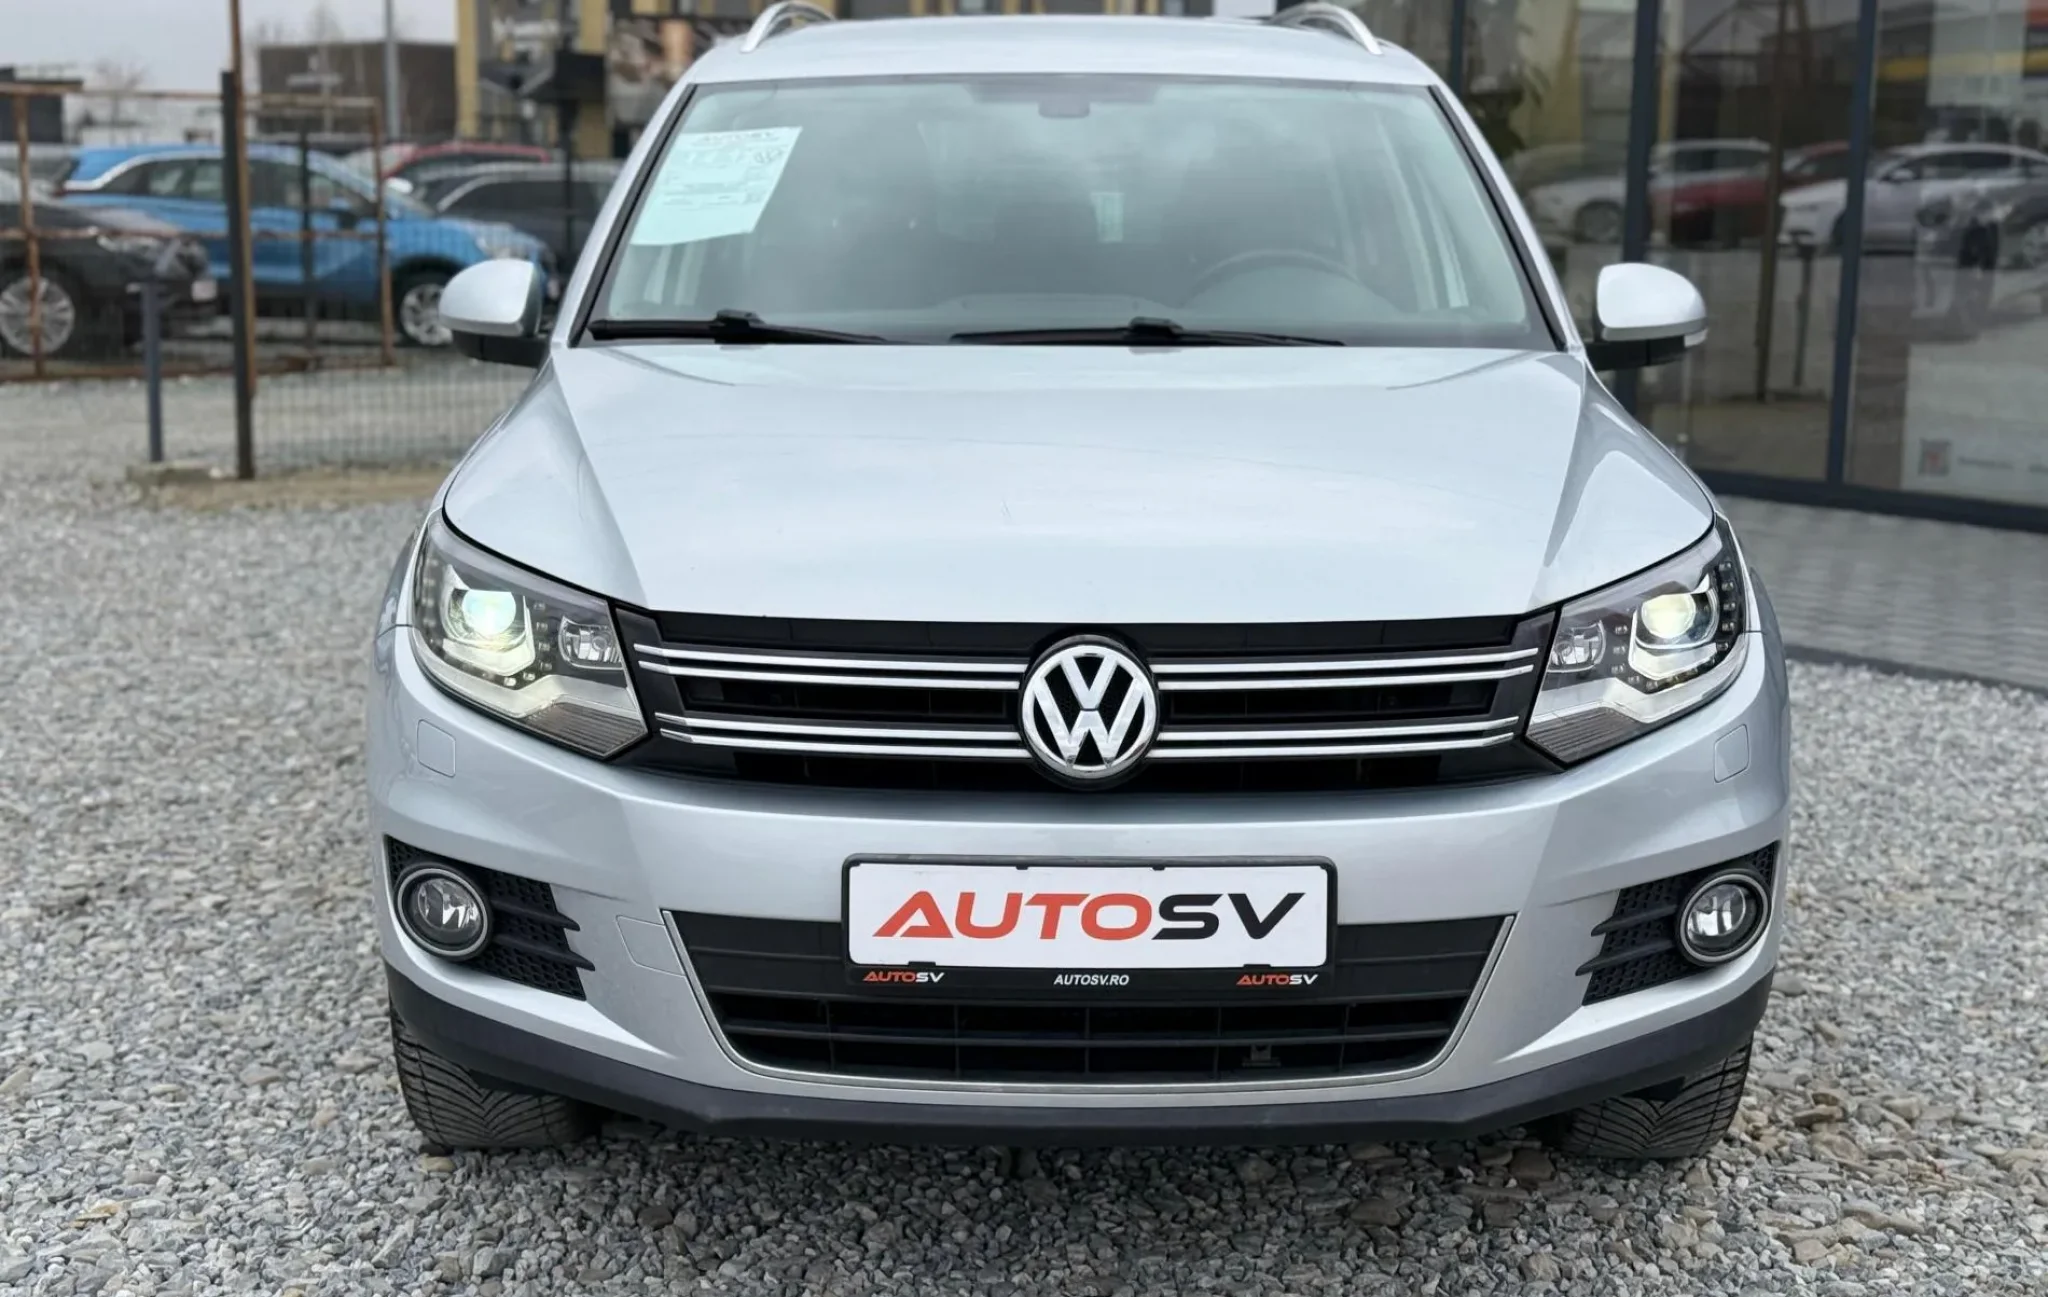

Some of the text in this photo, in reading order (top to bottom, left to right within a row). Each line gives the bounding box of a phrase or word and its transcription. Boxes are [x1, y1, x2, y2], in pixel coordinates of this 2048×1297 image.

[874, 890, 1306, 940] AUTOSV
[863, 971, 945, 983] AUTOSV
[1053, 974, 1130, 986] AUTOSV.RO
[1236, 974, 1318, 985] AUTOSV
